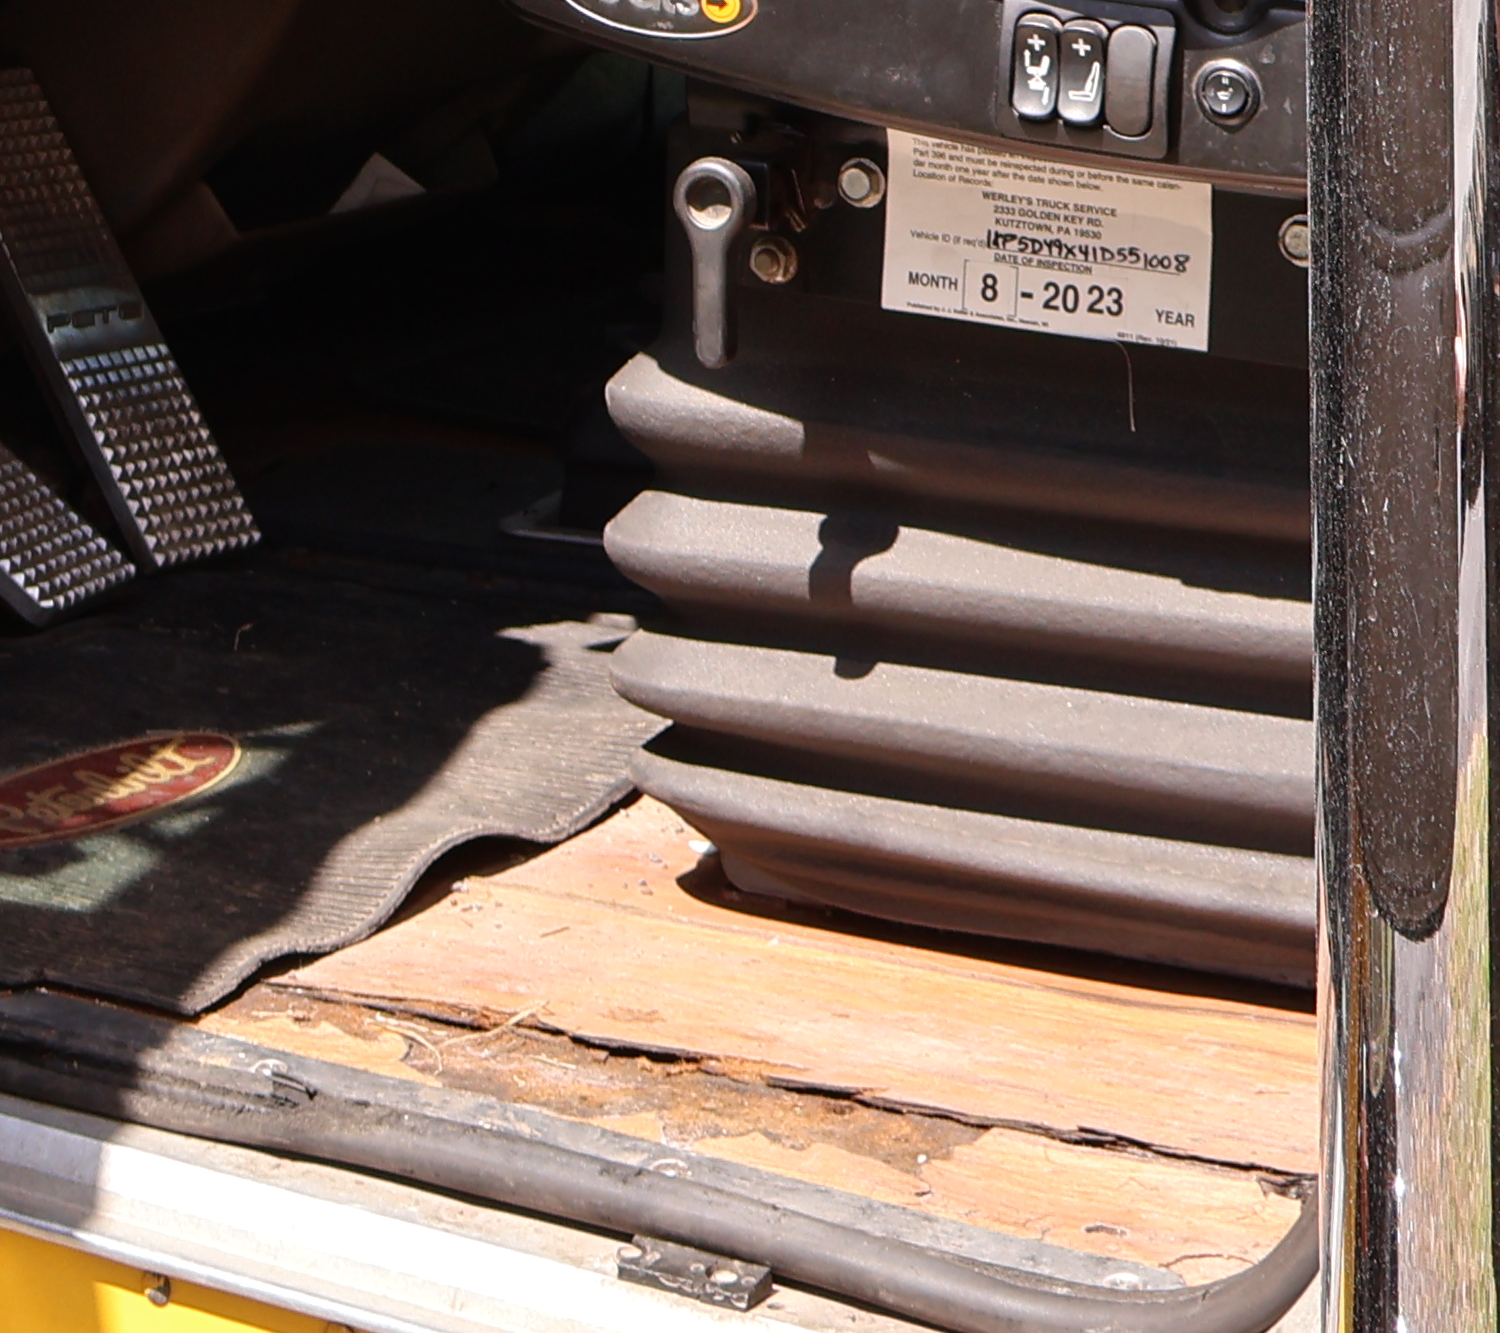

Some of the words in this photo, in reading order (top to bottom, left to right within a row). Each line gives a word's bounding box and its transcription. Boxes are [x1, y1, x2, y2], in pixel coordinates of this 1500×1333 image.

[981, 190, 1033, 206] WERLEY'S
[1036, 197, 1071, 211] TRUCK
[1073, 203, 1118, 217] SERVICE
[993, 205, 1015, 217] 2333
[1018, 208, 1061, 222] GOLDEN
[1063, 215, 1084, 226] KEY
[910, 229, 939, 242] Vehicle
[942, 234, 951, 243] ID
[1057, 225, 1071, 236] PA
[994, 253, 1018, 265] DATE
[1021, 256, 1034, 266] OF
[1036, 259, 1092, 274] INSPECTION
[908, 271, 959, 291] MONTH
[980, 273, 998, 303] 8
[1155, 308, 1196, 328] YEAR
